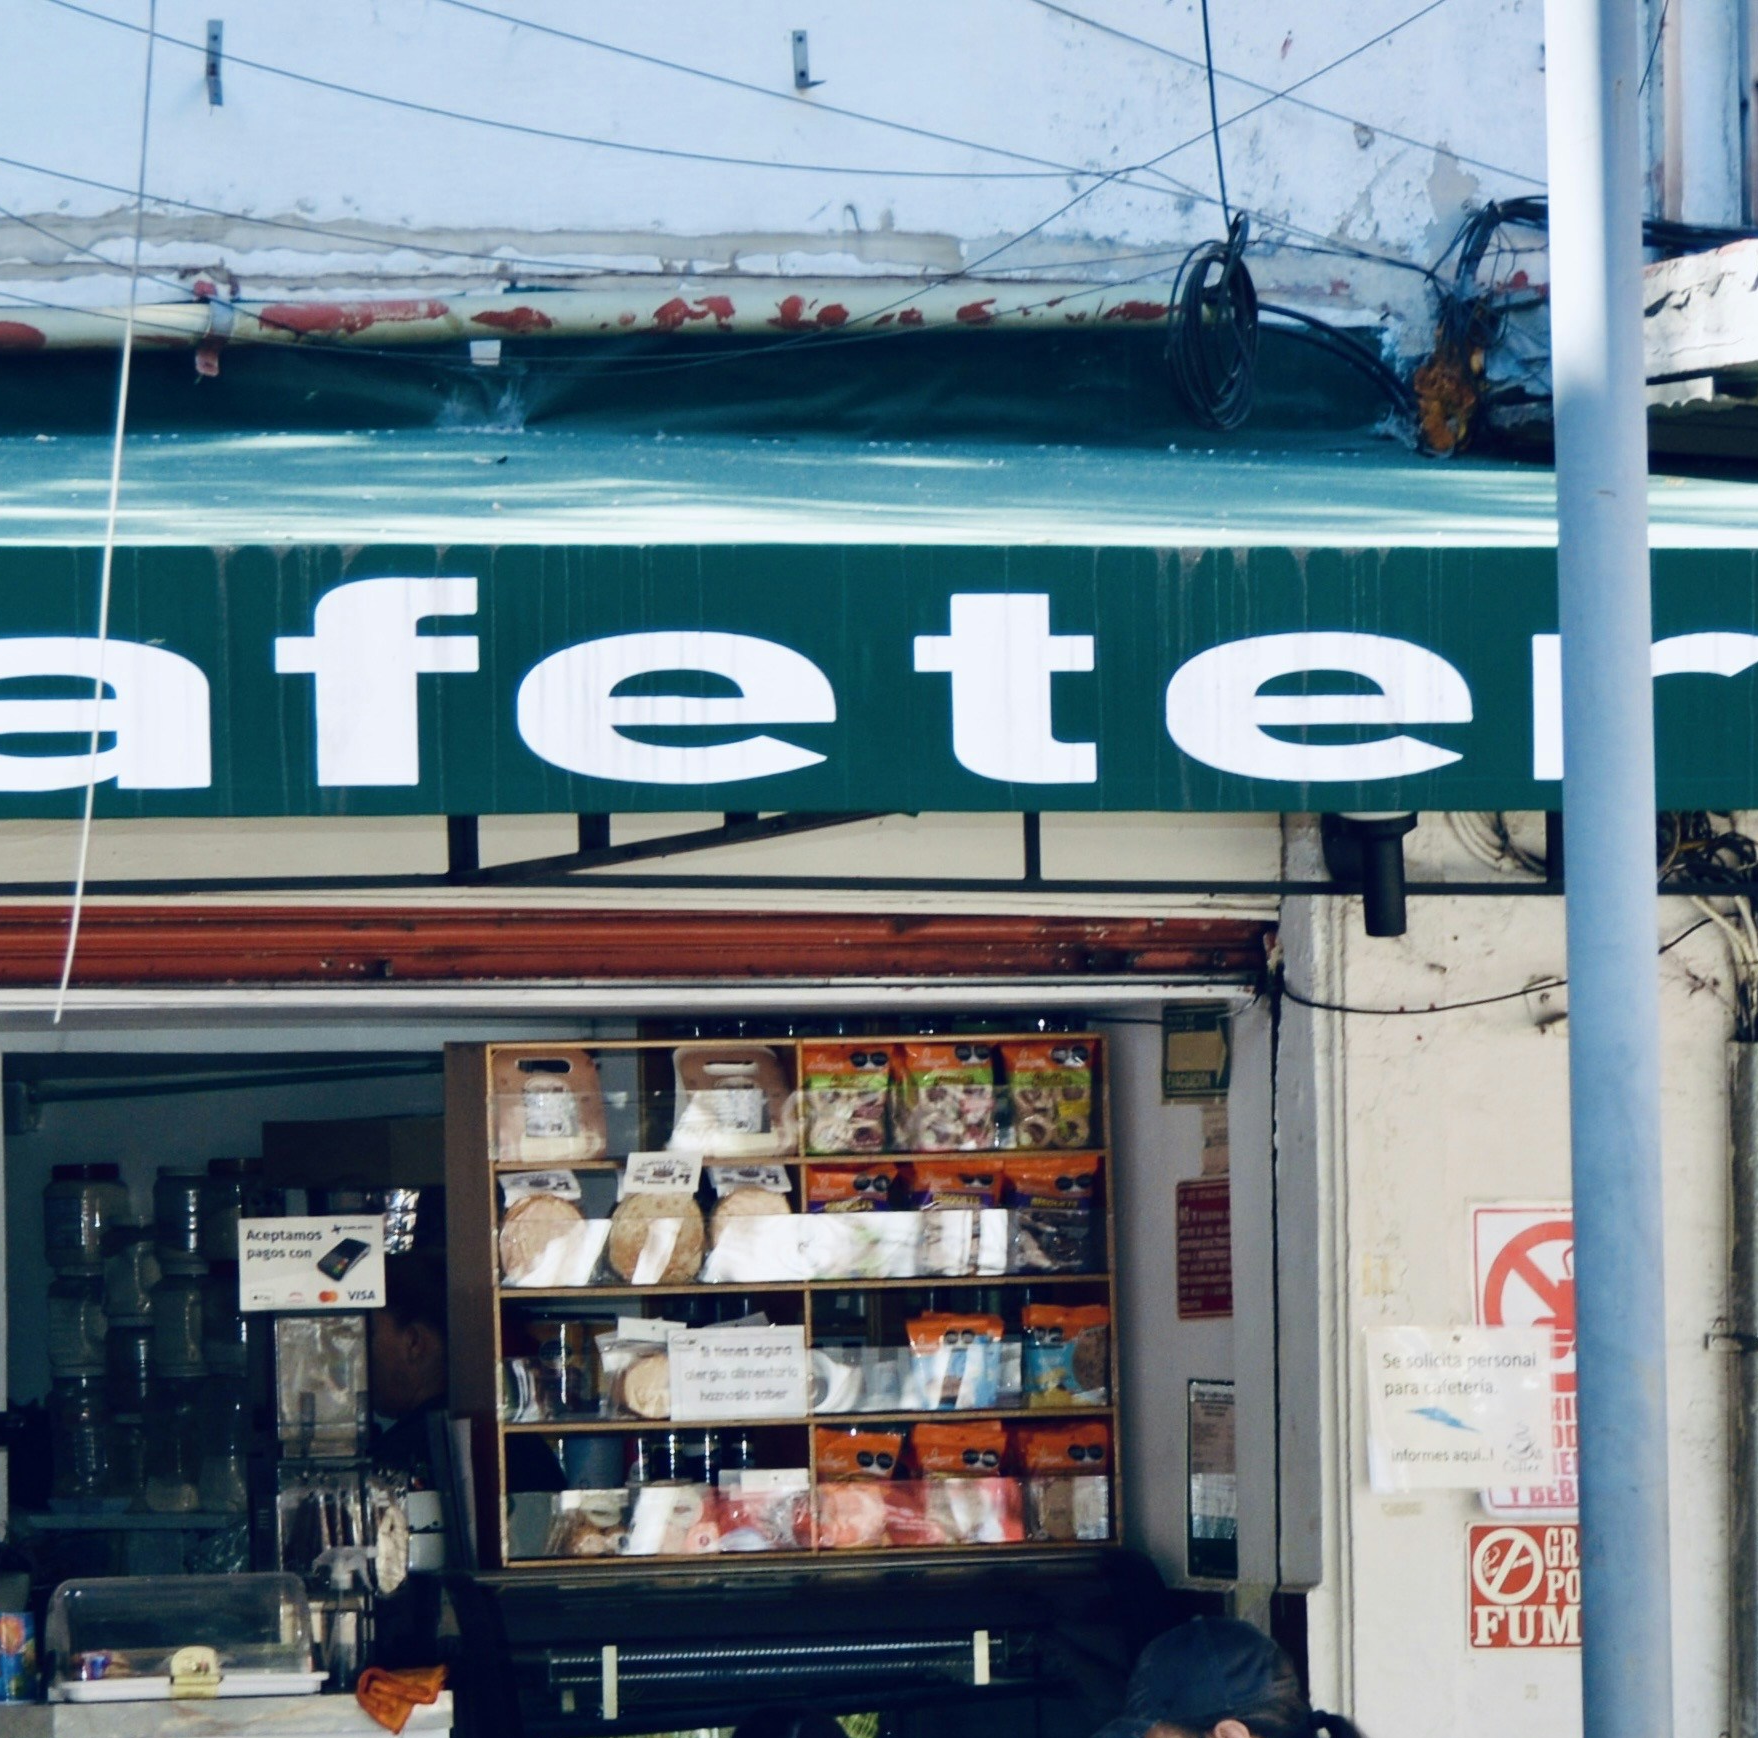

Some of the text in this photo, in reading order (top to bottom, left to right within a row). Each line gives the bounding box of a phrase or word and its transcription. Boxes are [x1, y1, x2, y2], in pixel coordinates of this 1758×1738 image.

[246, 1229, 322, 1242] Aceptamos
[247, 1248, 312, 1261] pagos con
[347, 1290, 376, 1301] VISA
[1382, 1353, 1401, 1369] Se
[1405, 1352, 1463, 1369] solicita
[1384, 1382, 1420, 1397] para
[1545, 1568, 1582, 1605] PO
[1473, 1604, 1583, 1647] FUM
